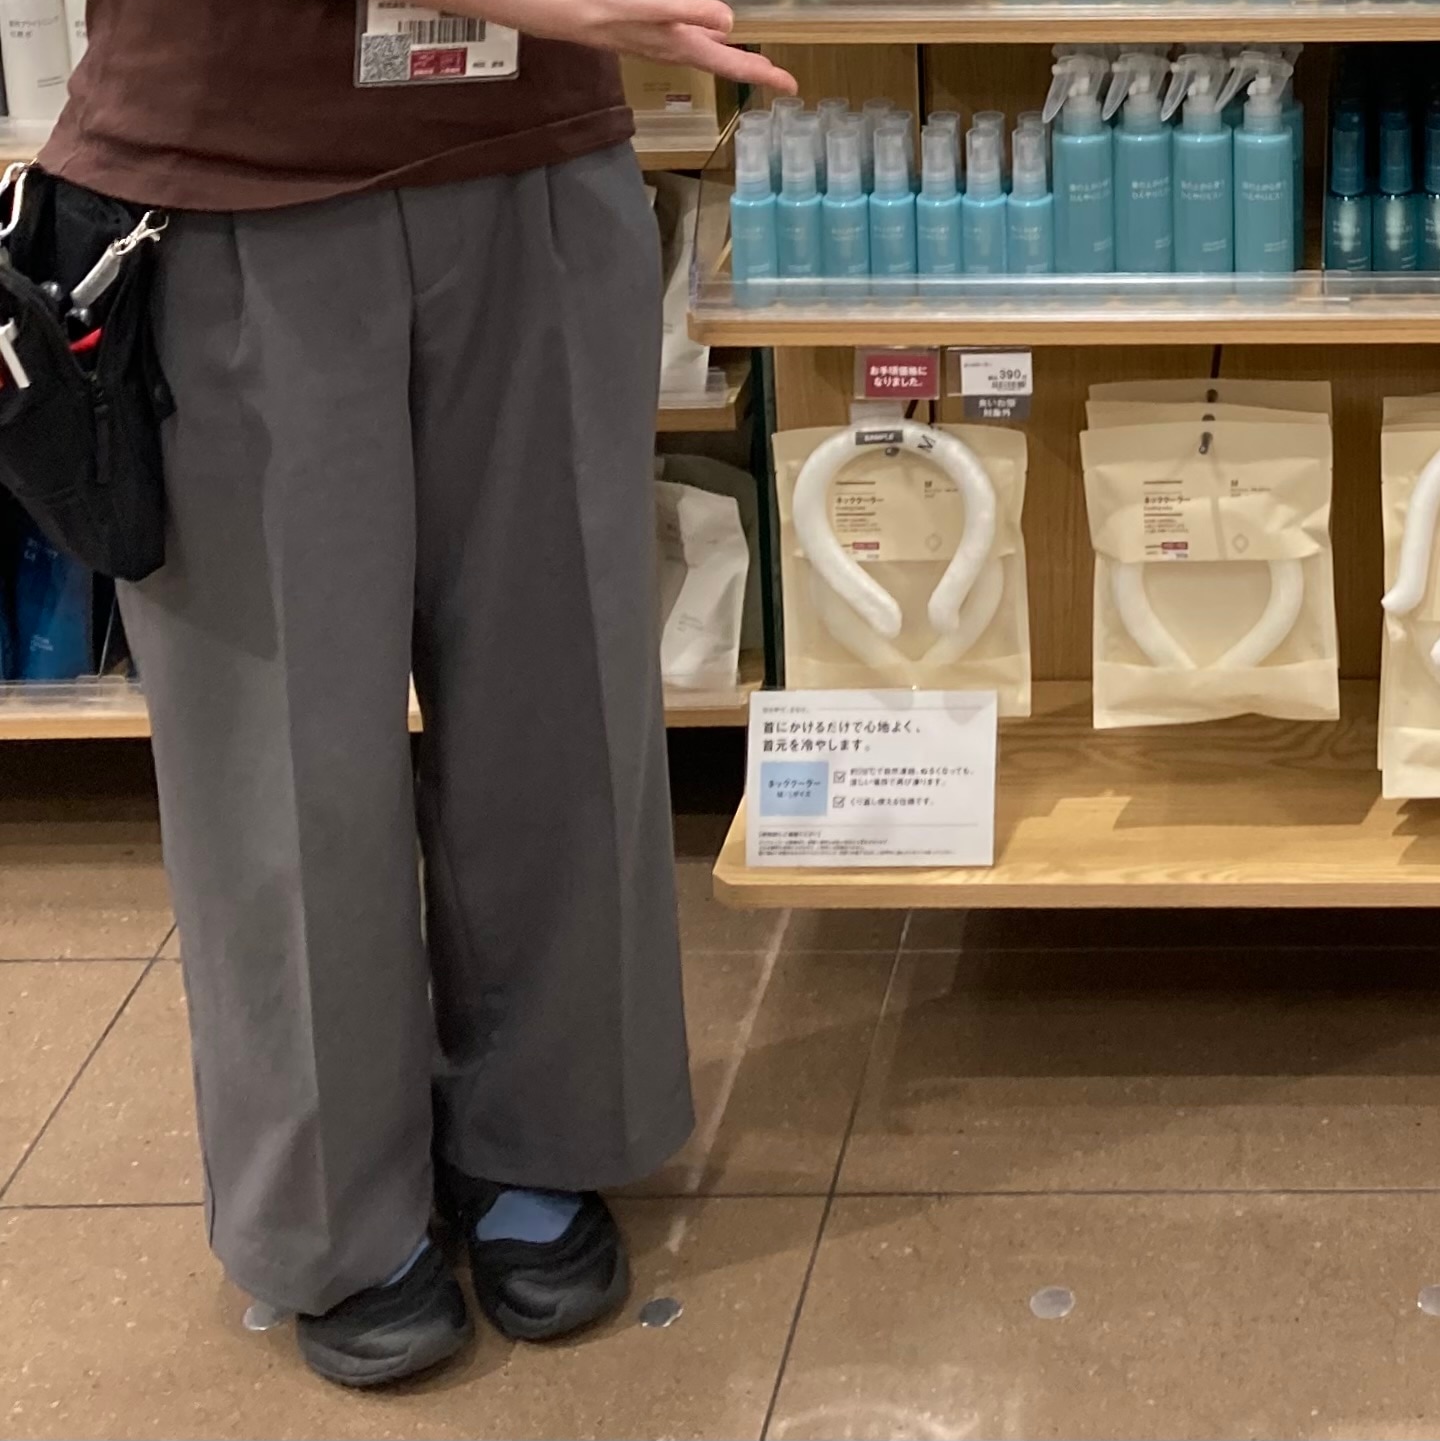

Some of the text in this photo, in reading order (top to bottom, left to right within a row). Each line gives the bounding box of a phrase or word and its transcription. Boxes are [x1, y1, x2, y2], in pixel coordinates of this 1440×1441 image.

[870, 366, 928, 376] お手頃価格に
[874, 377, 923, 387] なりました。
[917, 434, 936, 452] M
[762, 737, 871, 753] 首元を冷やします。
